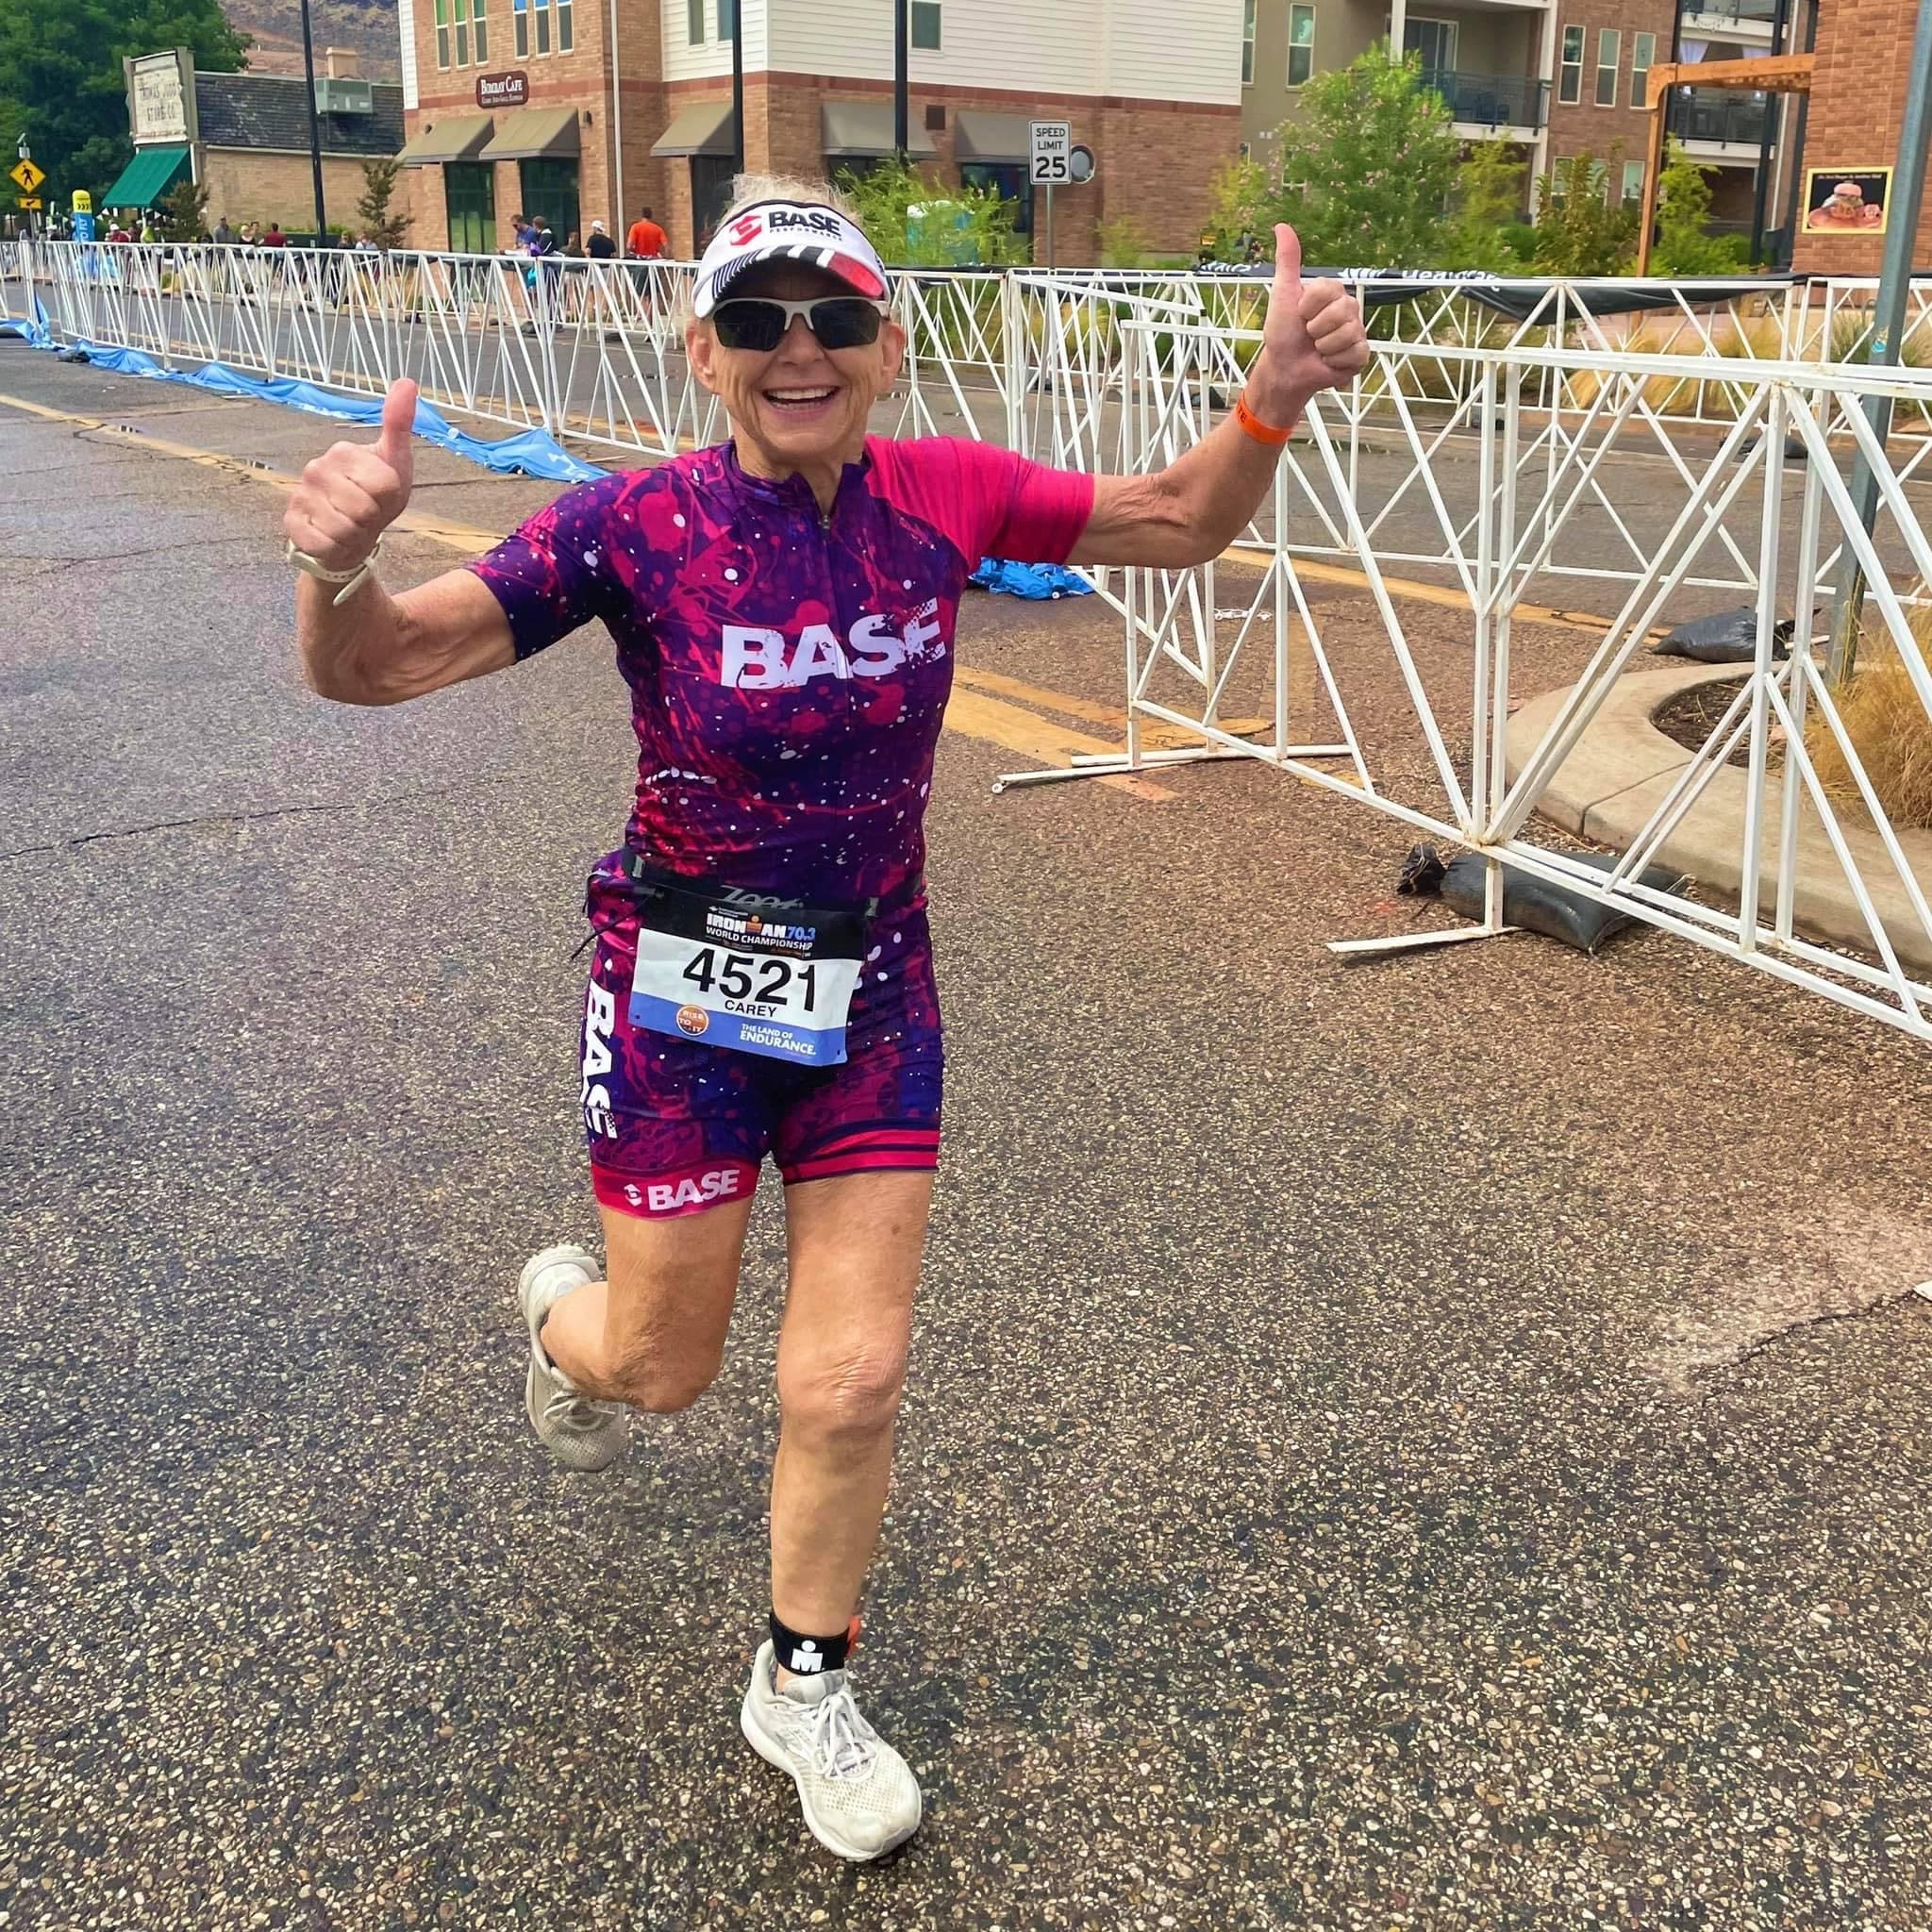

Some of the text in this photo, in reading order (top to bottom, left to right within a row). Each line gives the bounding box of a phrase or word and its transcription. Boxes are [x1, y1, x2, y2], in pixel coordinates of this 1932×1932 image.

[1036, 127, 1066, 138] SPEED
[1038, 141, 1063, 151] LIMIT
[1036, 156, 1066, 178] 25
[769, 210, 841, 237] BASE
[770, 227, 842, 242] PERFORMANCE
[721, 597, 946, 690] BASE
[706, 926, 740, 941] WORLD
[683, 948, 815, 1012] 4521
[682, 1010, 704, 1020] RISE
[724, 1000, 777, 1017] CAREY
[741, 1024, 757, 1032] THE
[758, 1026, 779, 1036] LAND
[579, 978, 619, 1140] BASE
[648, 1170, 741, 1211] BASE
